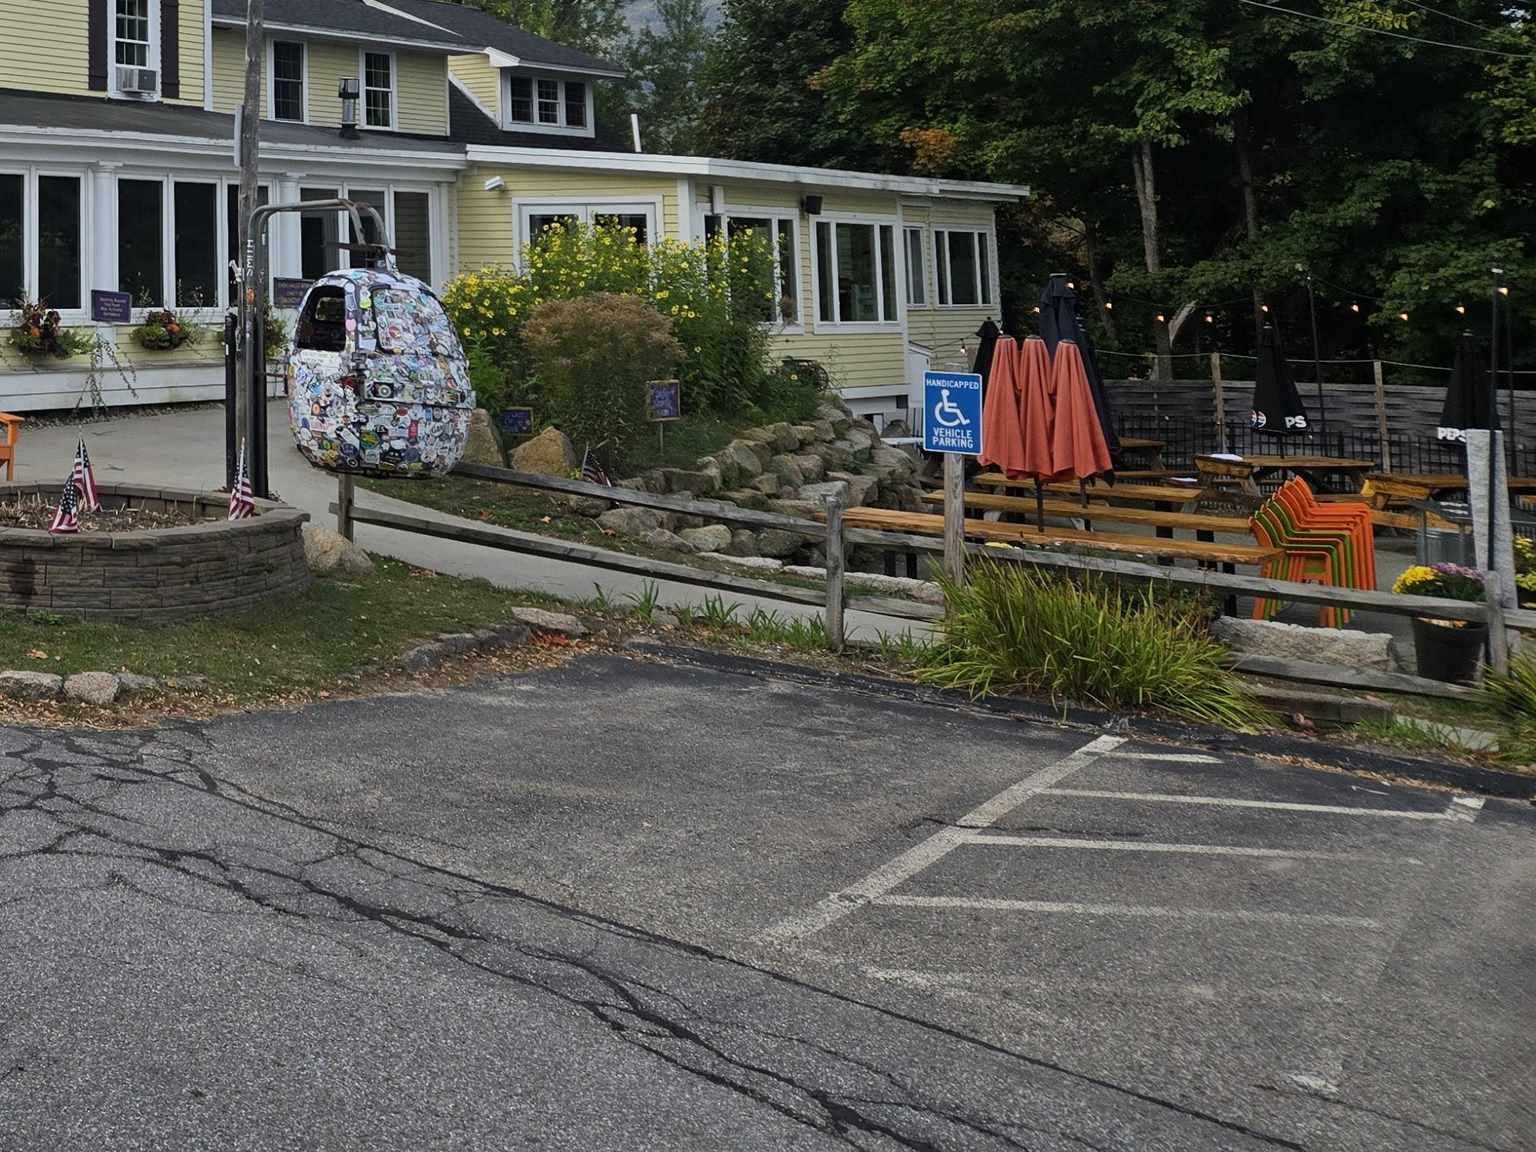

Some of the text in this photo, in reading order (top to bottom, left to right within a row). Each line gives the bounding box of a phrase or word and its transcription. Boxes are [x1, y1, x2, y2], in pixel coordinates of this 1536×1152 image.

[926, 378, 980, 390] HANDICAPPED
[932, 427, 973, 439] VEHICLE
[932, 436, 974, 449] PARKING
